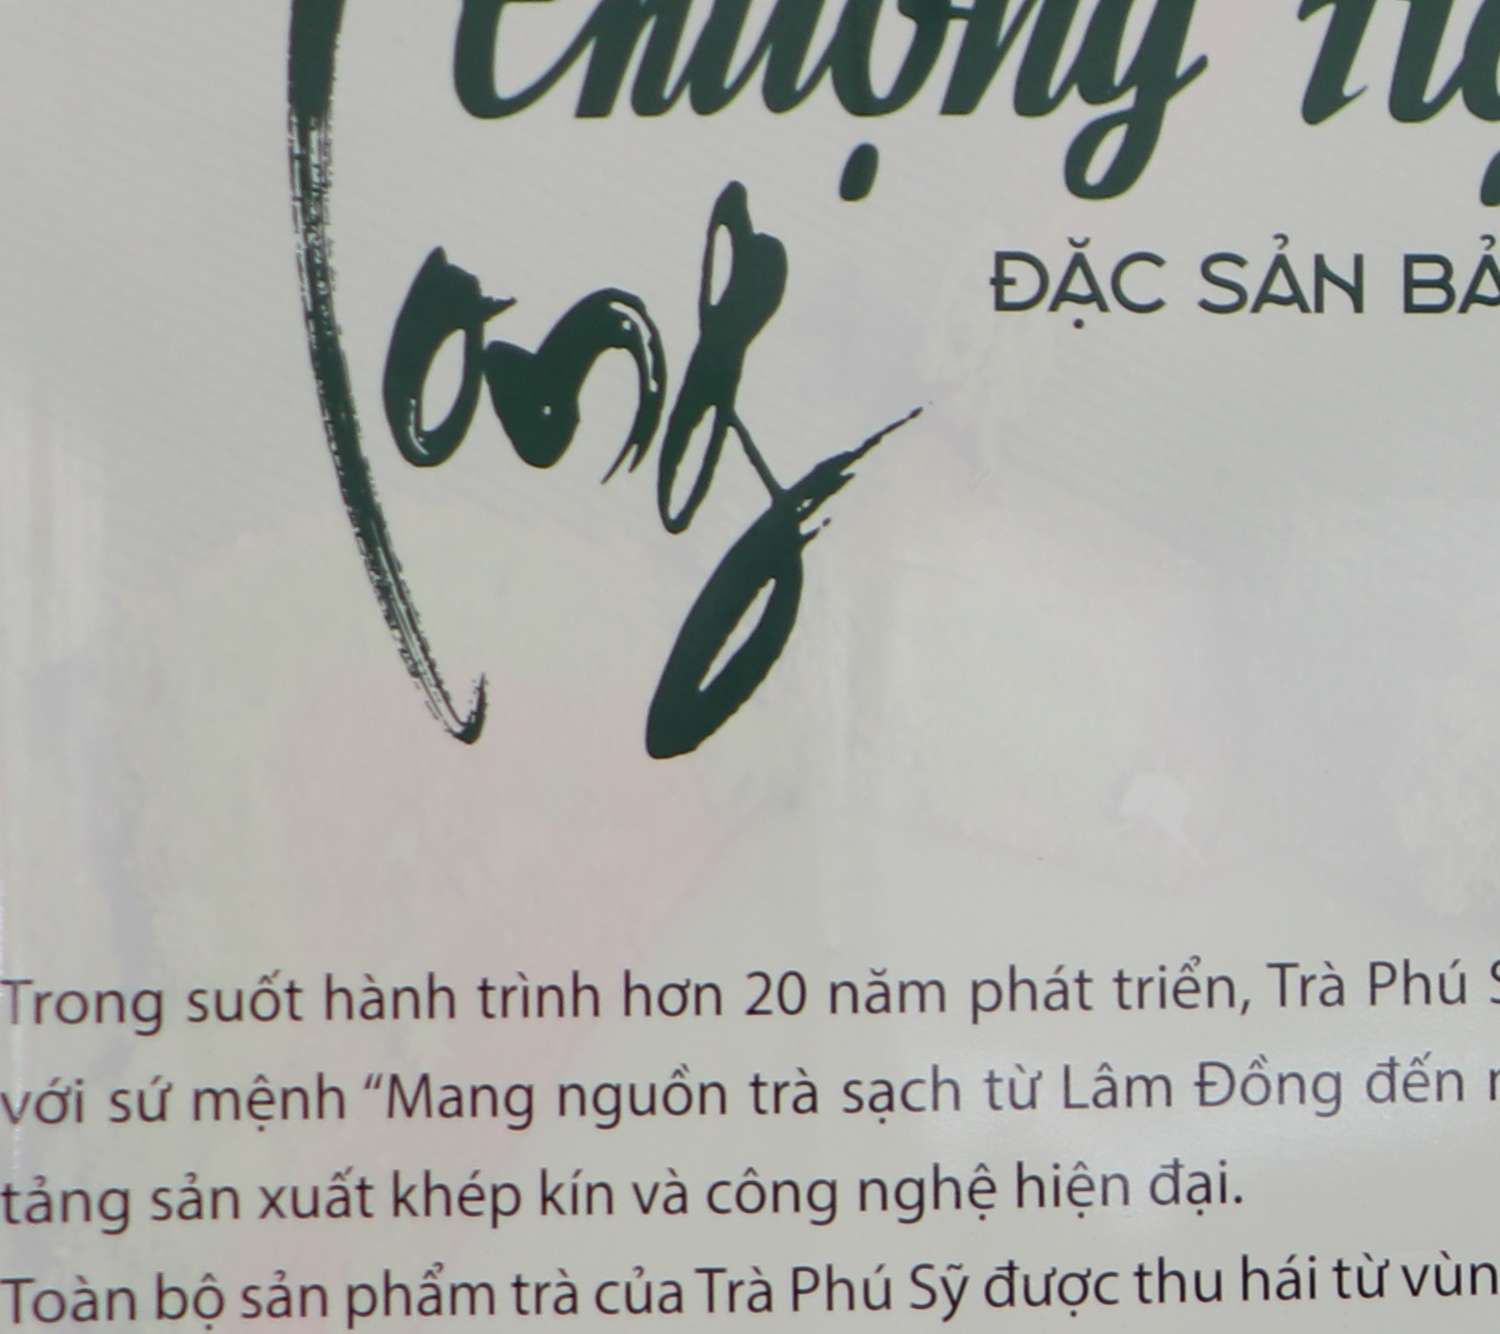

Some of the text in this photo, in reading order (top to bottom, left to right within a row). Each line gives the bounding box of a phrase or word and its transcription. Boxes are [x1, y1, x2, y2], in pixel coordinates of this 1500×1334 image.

[989, 237, 1166, 329] ĐẶC
[1200, 232, 1364, 318] SẢN
[0, 979, 163, 1036] Trong
[188, 970, 303, 1023] suốt
[325, 971, 455, 1021] hành
[477, 970, 600, 1019] trình
[624, 969, 722, 1017] hơn
[745, 970, 807, 1016] 20
[830, 968, 946, 1014] năm
[972, 964, 1093, 1025] phát
[1112, 955, 1250, 1015] triển,
[1266, 961, 1344, 1007] Trà
[1370, 958, 1466, 1006] Phú
[0, 1077, 83, 1125] với
[109, 1075, 173, 1123] sứ
[193, 1072, 345, 1132] mệnh
[364, 1073, 533, 1131] “Mang
[559, 1063, 726, 1130] nguồn
[749, 1067, 818, 1115] trà
[843, 1064, 960, 1124] sạch
[984, 1064, 1042, 1111] từ
[1064, 1062, 1172, 1109] Lâm
[1194, 1054, 1341, 1117] Đồng
[1366, 1051, 1463, 1103] đến
